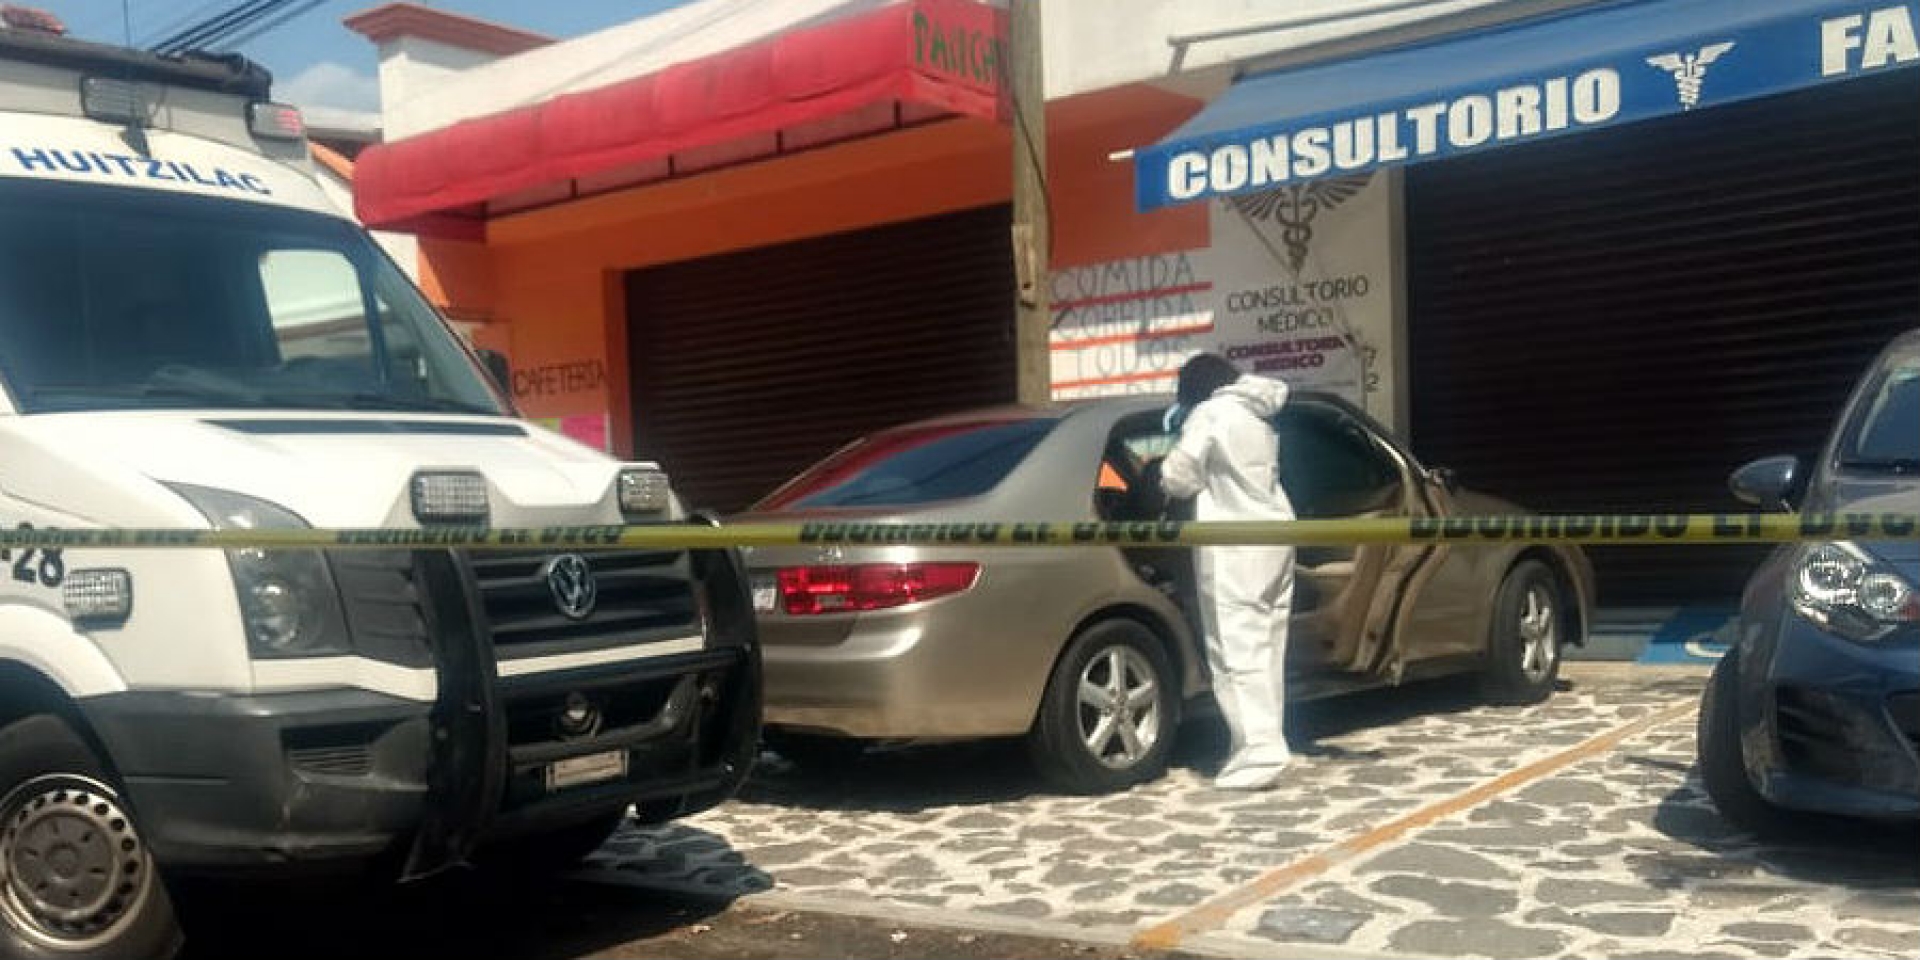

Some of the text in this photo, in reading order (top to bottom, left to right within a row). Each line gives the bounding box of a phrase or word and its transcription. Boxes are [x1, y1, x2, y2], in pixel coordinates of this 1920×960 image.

[1167, 4, 1920, 199] CONSULTORIO FA
[11, 147, 271, 195] HUITZILAC
[1052, 252, 1196, 304] COMIDA
[1227, 274, 1368, 313] CONSULTORIO
